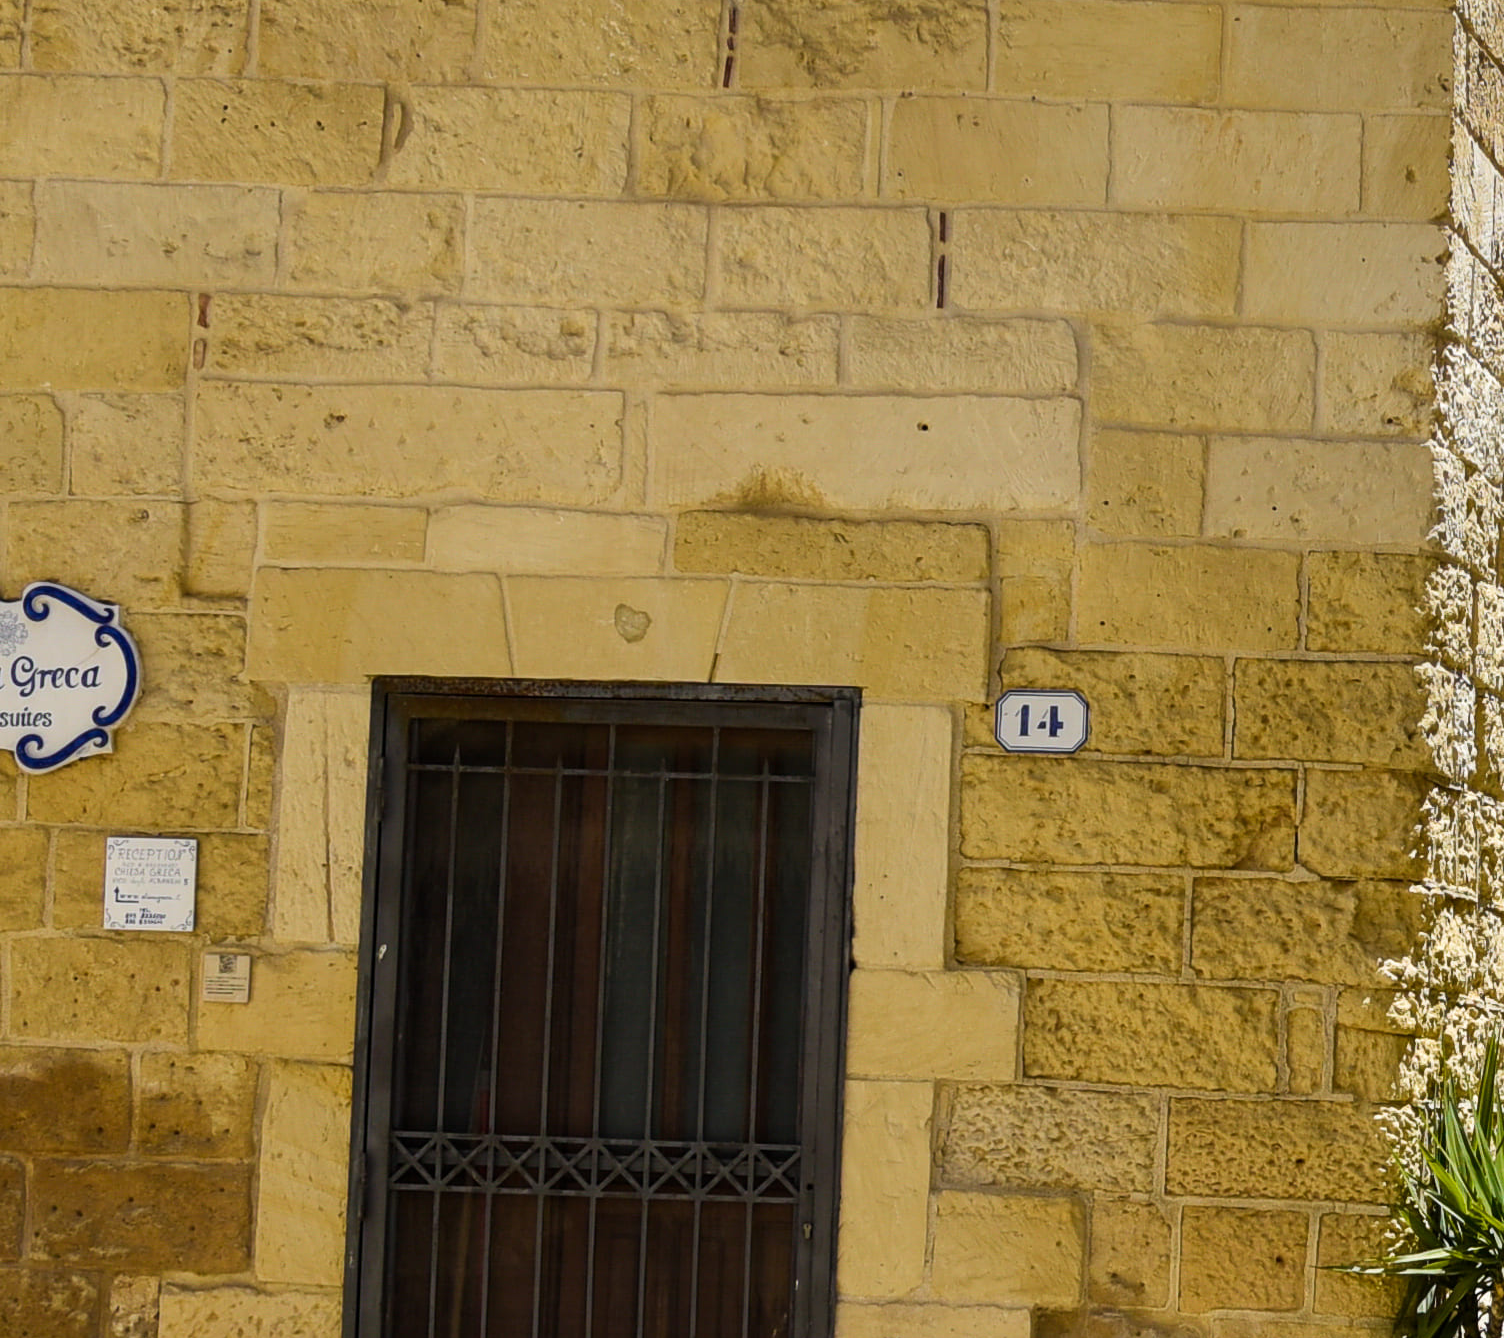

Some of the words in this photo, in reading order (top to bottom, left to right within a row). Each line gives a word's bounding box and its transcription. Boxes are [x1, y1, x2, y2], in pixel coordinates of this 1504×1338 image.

[10, 655, 102, 697] Greca
[1015, 704, 1064, 737] 14
[117, 848, 187, 861] RECEPTION
